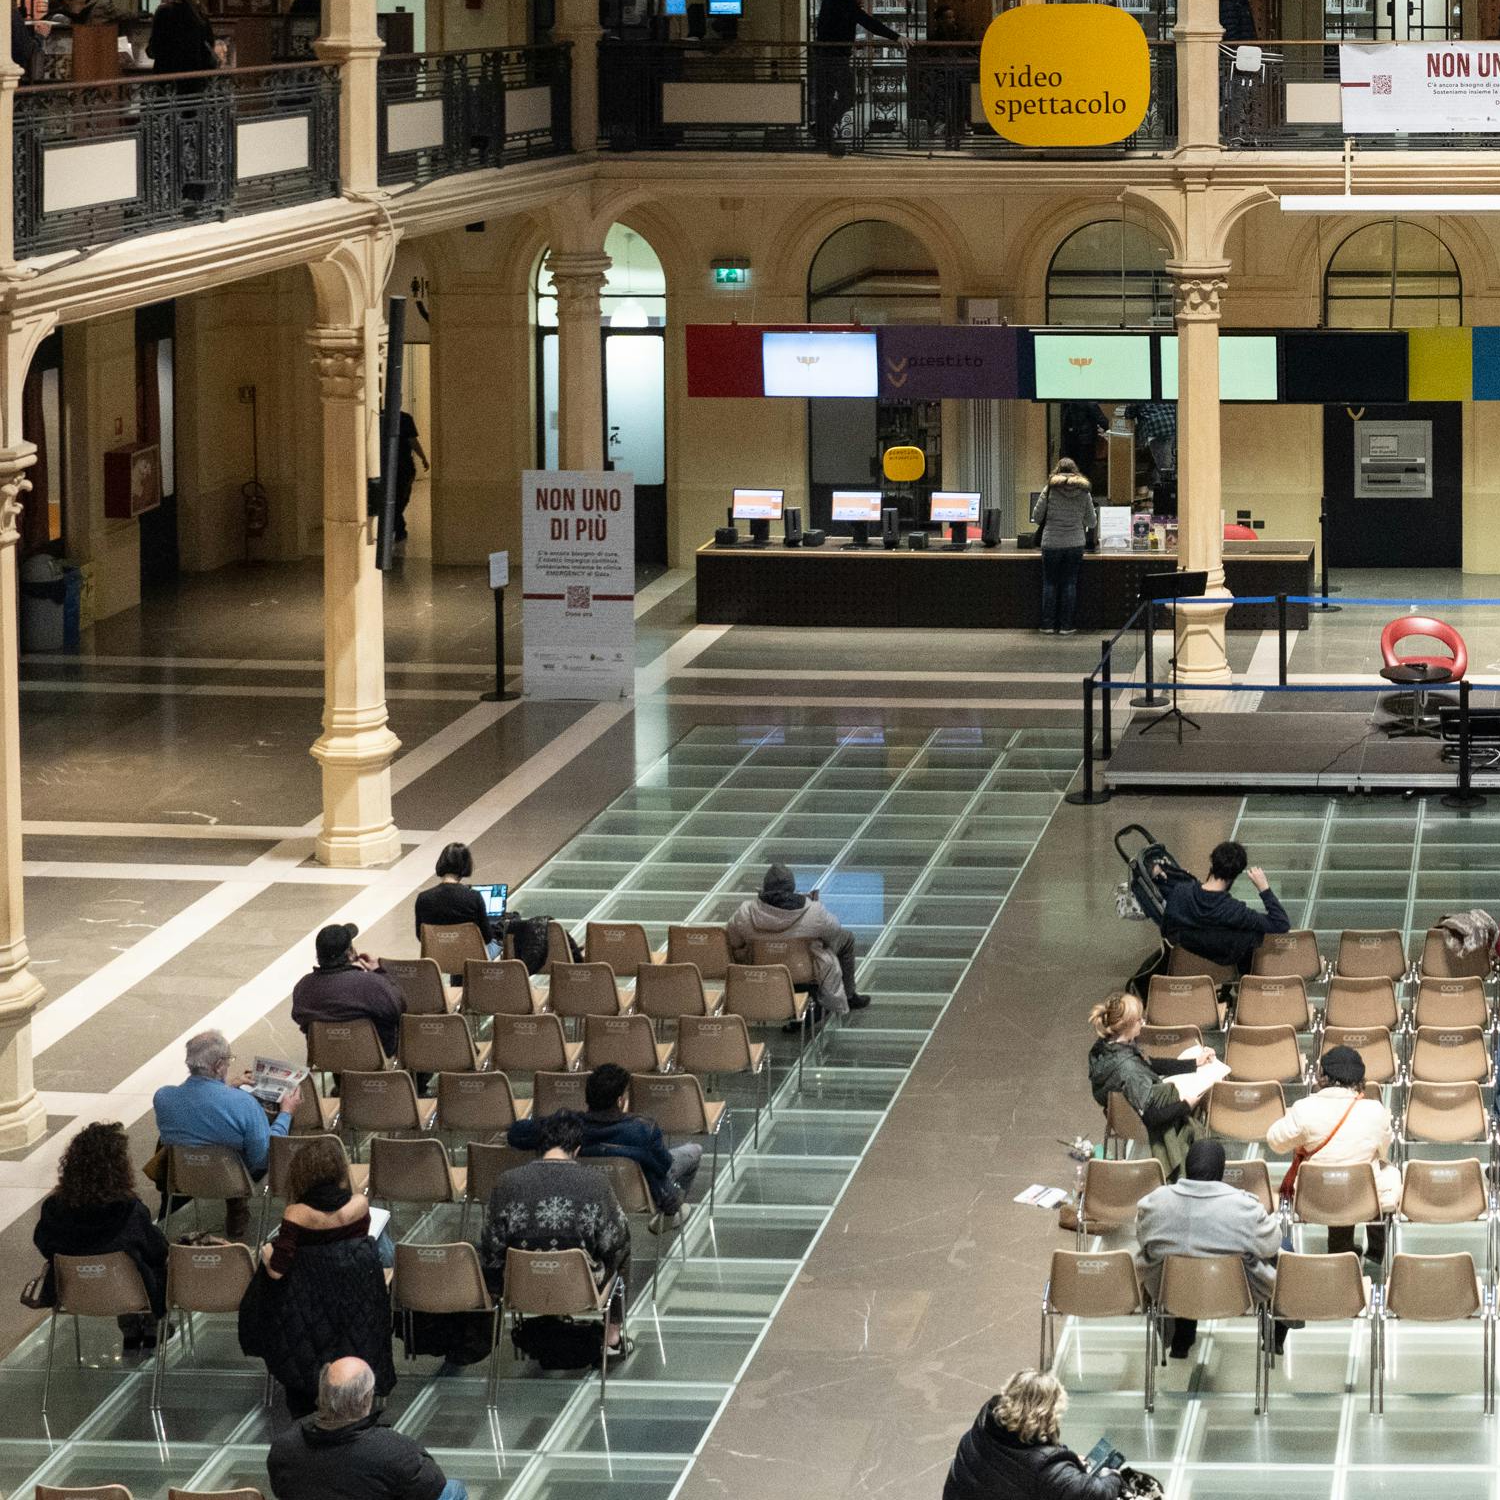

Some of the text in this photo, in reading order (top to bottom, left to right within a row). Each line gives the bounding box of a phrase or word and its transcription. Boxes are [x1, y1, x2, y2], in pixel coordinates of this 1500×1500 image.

[993, 64, 1063, 89] video
[1427, 52, 1470, 77] NON
[993, 91, 1127, 122] spettacolo
[536, 488, 621, 512] NON UNO
[550, 513, 606, 542] DI PIÙ
